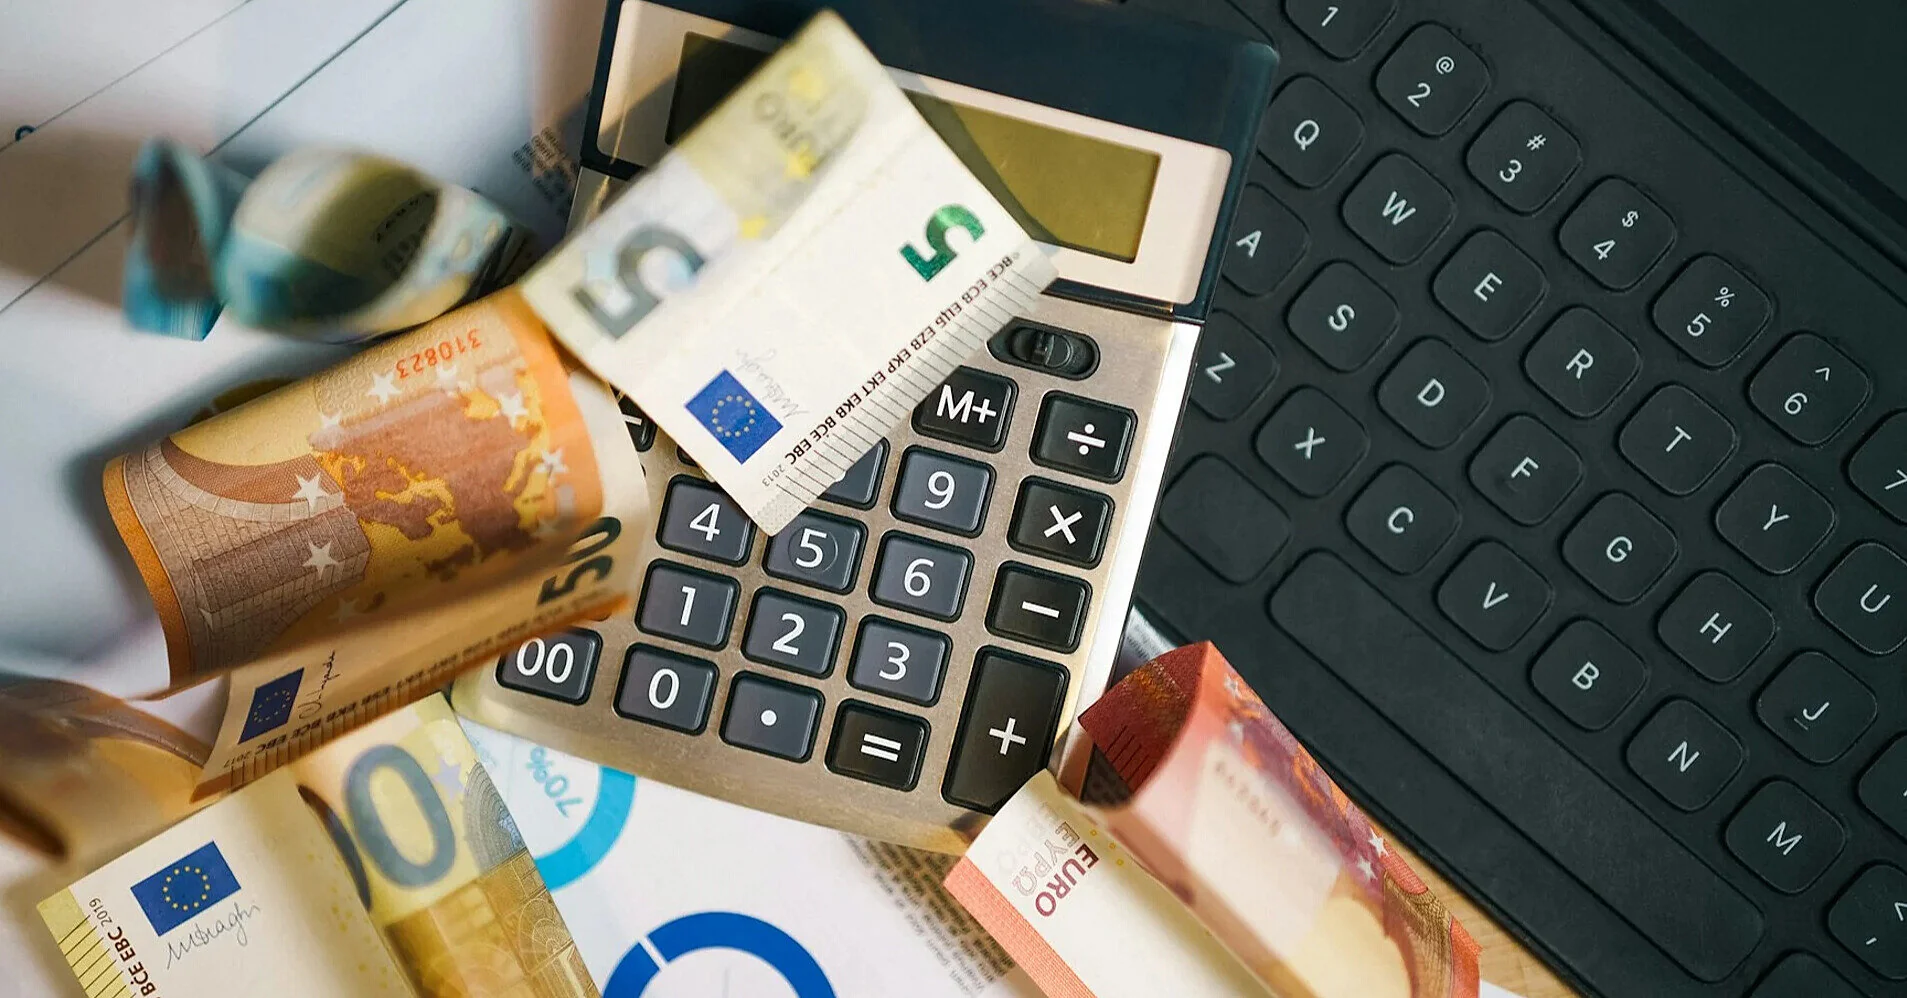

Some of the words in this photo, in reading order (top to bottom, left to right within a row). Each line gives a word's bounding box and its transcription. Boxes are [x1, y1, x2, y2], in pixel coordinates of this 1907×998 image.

[1322, 6, 1339, 27] 1
[1407, 82, 1431, 108] 2
[1293, 119, 1320, 151] Q
[1499, 159, 1522, 183] 3
[1382, 190, 1417, 225] W
[899, 203, 986, 283] 5
[1235, 230, 1262, 258] A
[1593, 239, 1616, 260] 4
[570, 221, 707, 342] 5
[961, 279, 988, 304] ECB
[1474, 272, 1503, 302] E
[1328, 304, 1355, 331] S
[1686, 312, 1712, 337] 5
[910, 325, 937, 351] EZB
[395, 327, 482, 380] 310823
[886, 348, 912, 374] EKP
[1205, 352, 1236, 383] Z
[1565, 348, 1594, 380] R
[861, 370, 886, 397] EKT
[1417, 378, 1445, 407] D
[835, 392, 862, 419] EKB
[936, 383, 998, 422] M+
[1784, 392, 1808, 415] 6
[784, 438, 812, 465] EBC
[1294, 427, 1326, 459] X
[1665, 425, 1692, 452] T
[761, 463, 786, 488] 2013
[1511, 456, 1539, 478] F
[924, 470, 955, 510] 9
[689, 503, 720, 542] 4
[1387, 506, 1414, 534] C
[1763, 504, 1790, 531] Y
[795, 528, 827, 568] 5
[1606, 536, 1633, 563] G
[904, 558, 935, 597] 6
[680, 585, 696, 626] 1
[1483, 582, 1509, 609] V
[1860, 584, 1891, 613] U
[772, 612, 805, 656] 2
[1699, 612, 1732, 644] H
[516, 637, 574, 684] 00
[878, 641, 910, 681] 3
[648, 668, 680, 709] 0
[1571, 661, 1600, 690] B
[1802, 701, 1830, 721] J
[255, 734, 287, 752] EBC
[1667, 741, 1700, 773] N
[525, 746, 584, 818] 70%
[1766, 821, 1803, 856] M
[1034, 842, 1099, 918] EURO
[88, 897, 113, 928] 2019
[107, 925, 137, 963] EBC
